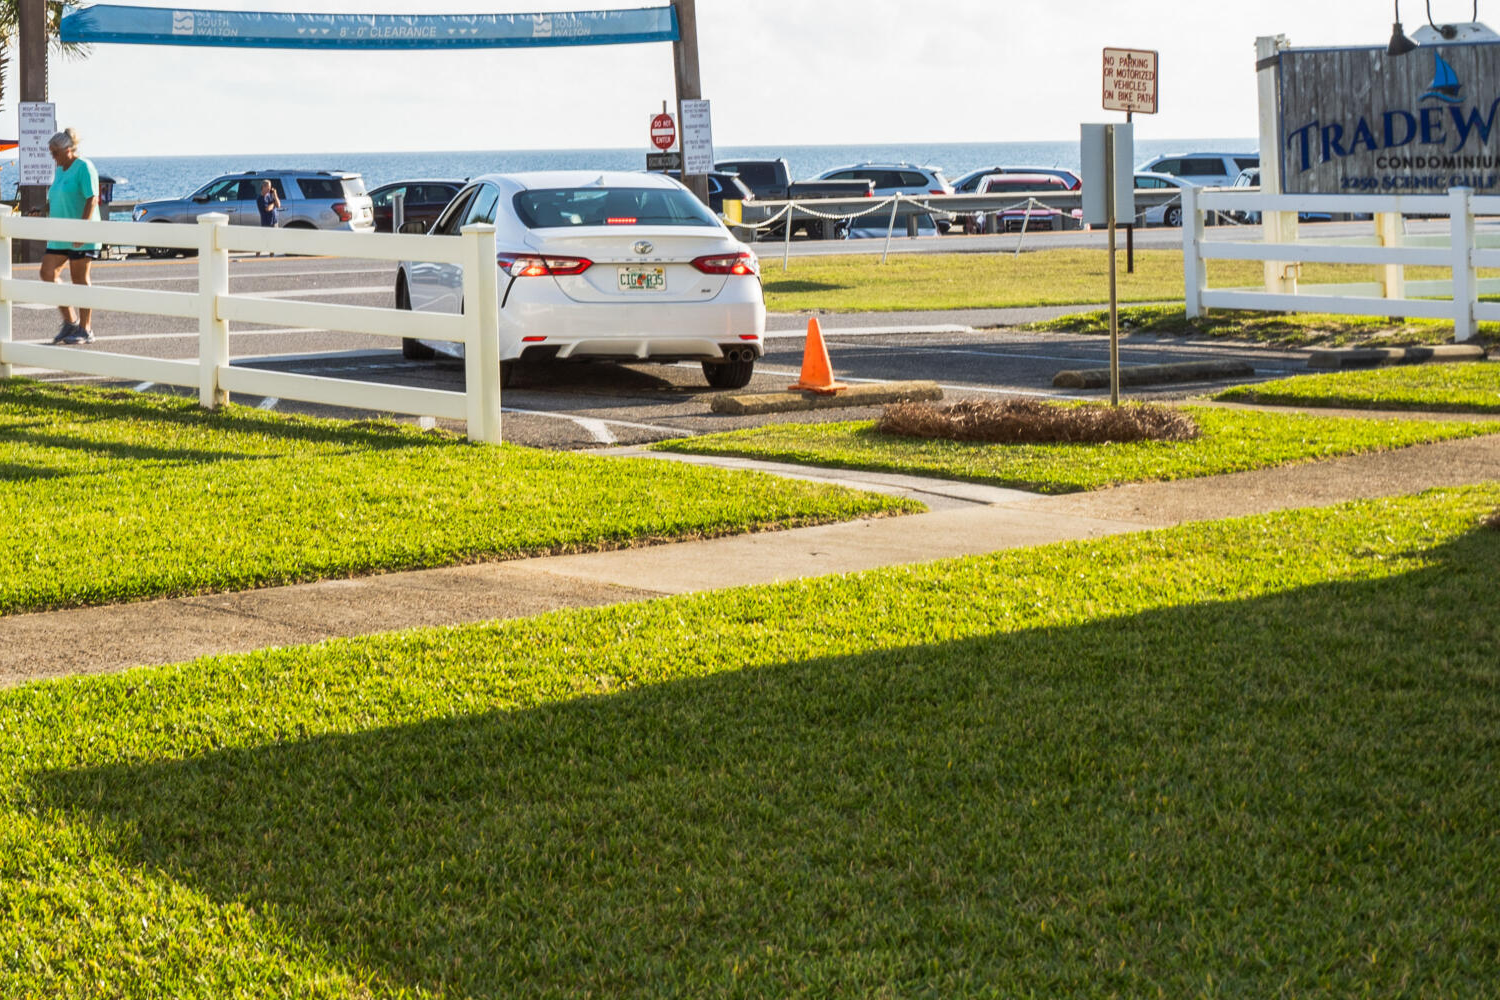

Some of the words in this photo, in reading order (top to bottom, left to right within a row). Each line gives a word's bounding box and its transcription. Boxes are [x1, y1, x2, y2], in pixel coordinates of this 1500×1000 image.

[197, 16, 229, 27] SOUTH
[196, 27, 238, 37] WALTON
[370, 26, 437, 38] CLEARANCE
[1104, 57, 1114, 65] NO
[1119, 57, 1148, 69] PARKING
[1104, 68, 1113, 77] OR
[1116, 68, 1155, 81] MOTORIZED
[1114, 80, 1146, 91] VEHICLES
[1104, 90, 1113, 99] ON
[1118, 91, 1133, 102] BIKE
[1137, 93, 1155, 104] PATH
[656, 136, 671, 144] ENTER
[1381, 175, 1446, 190] SCENIC
[1449, 175, 1498, 189] GULF
